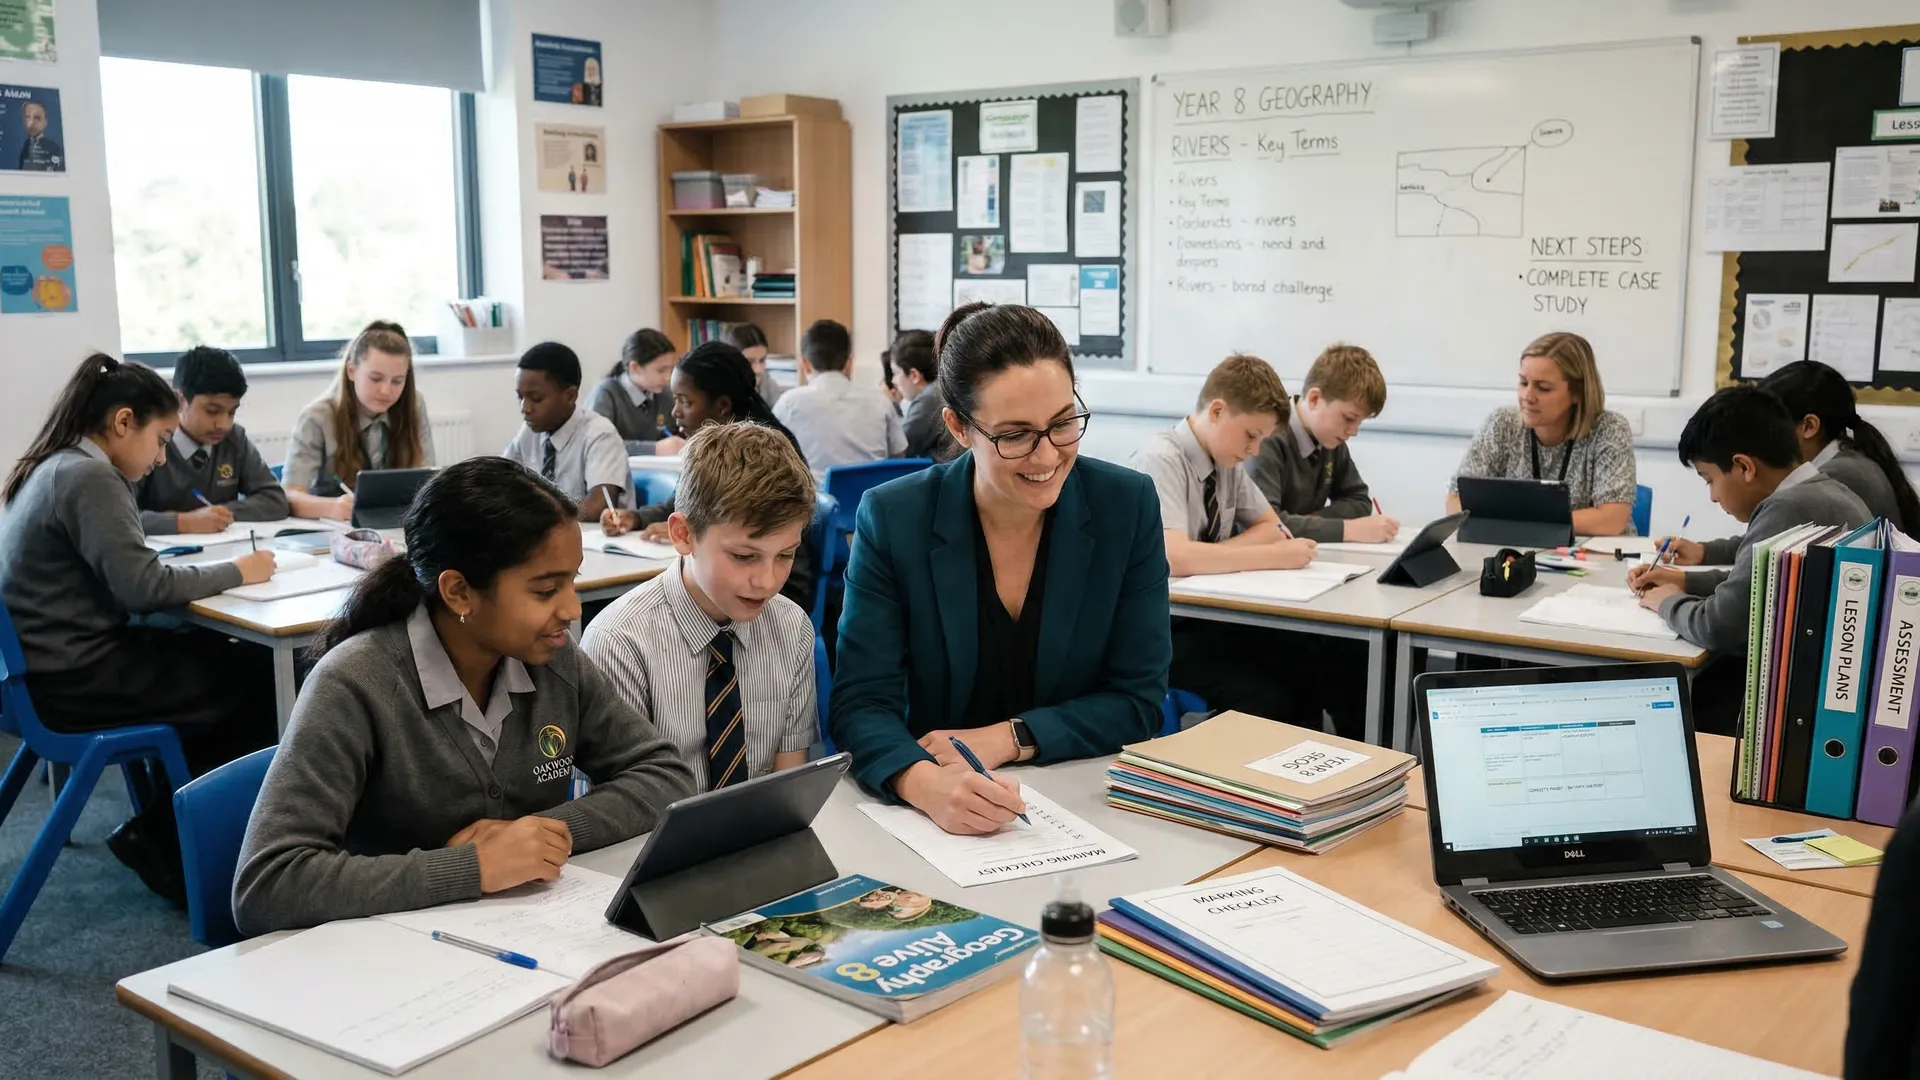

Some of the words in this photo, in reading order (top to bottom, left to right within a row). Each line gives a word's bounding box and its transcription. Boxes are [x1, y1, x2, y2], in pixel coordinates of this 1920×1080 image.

[1173, 90, 1221, 118] YEAR
[1233, 87, 1246, 114] 8
[1258, 81, 1373, 111] GEOGRAPHY
[1171, 134, 1230, 158] RIVERS
[1257, 131, 1285, 162] Key
[1290, 128, 1338, 149] Terms
[1177, 172, 1218, 187] Rivers
[1299, 236, 1325, 250] and
[1531, 236, 1578, 256] NEXT
[1586, 236, 1643, 256] STEPS
[1177, 277, 1215, 293] Rivers
[1273, 280, 1334, 303] challenge
[1526, 268, 1609, 288] COMPLETE
[1618, 271, 1663, 290] CASE
[1533, 294, 1589, 316] STUDY
[1839, 600, 1859, 654] LESSON
[1835, 656, 1852, 700] PLANS
[1887, 620, 1914, 714] ASSESSMENT
[1282, 751, 1326, 770] GEOG
[1312, 756, 1351, 773] YEAR
[1047, 848, 1106, 865] MARKING
[1564, 850, 1586, 859] DELL
[978, 859, 1044, 876] CHECKLIST
[1192, 886, 1265, 905] MARKING
[1207, 894, 1285, 916] CHECKLIST
[872, 931, 957, 967] Alive
[875, 927, 1025, 993] Geography
[836, 961, 881, 982] 8
